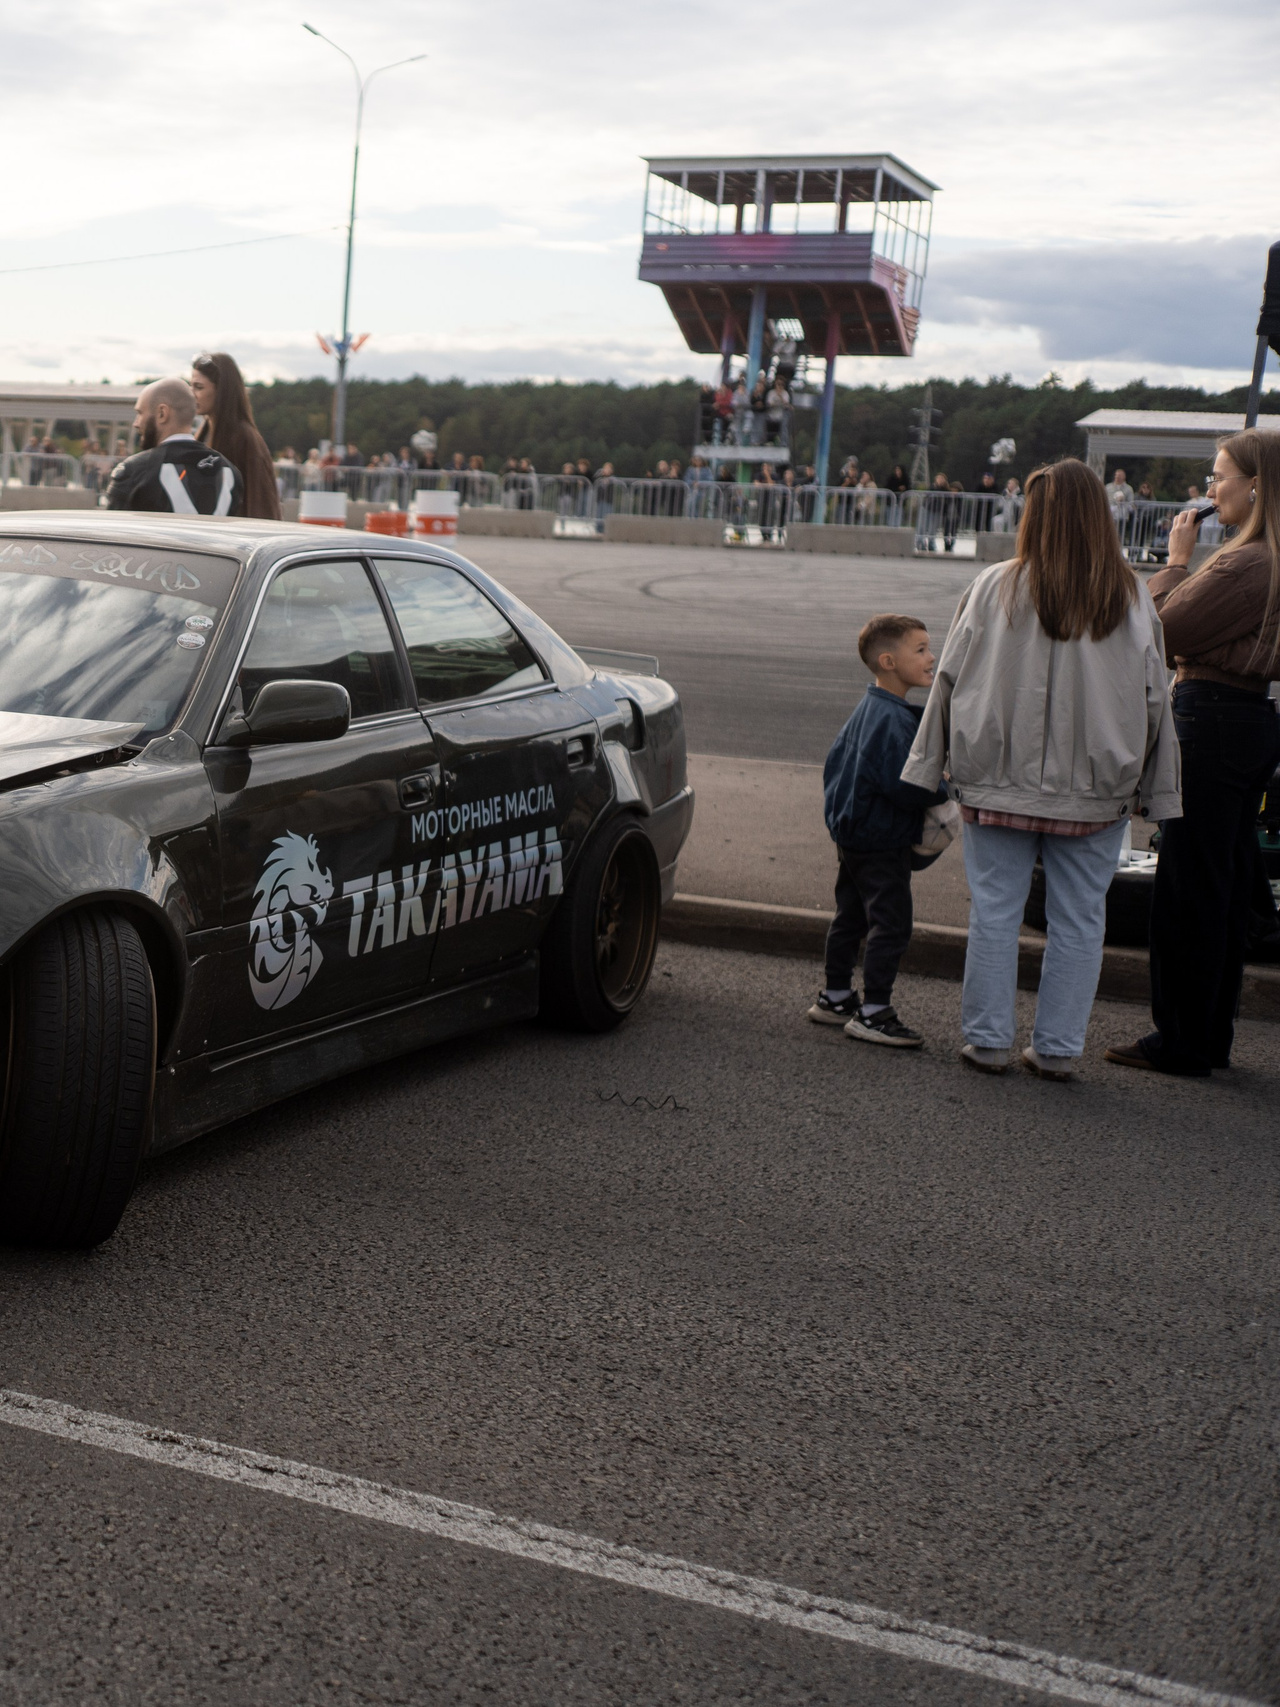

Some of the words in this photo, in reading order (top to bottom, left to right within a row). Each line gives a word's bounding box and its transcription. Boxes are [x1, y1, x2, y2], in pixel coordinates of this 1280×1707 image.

[71, 550, 201, 592] SQUAD
[411, 796, 503, 844] МОТОРНЫЕ
[505, 784, 556, 821] МАСЛА
[342, 826, 564, 958] TAKAYAMA
